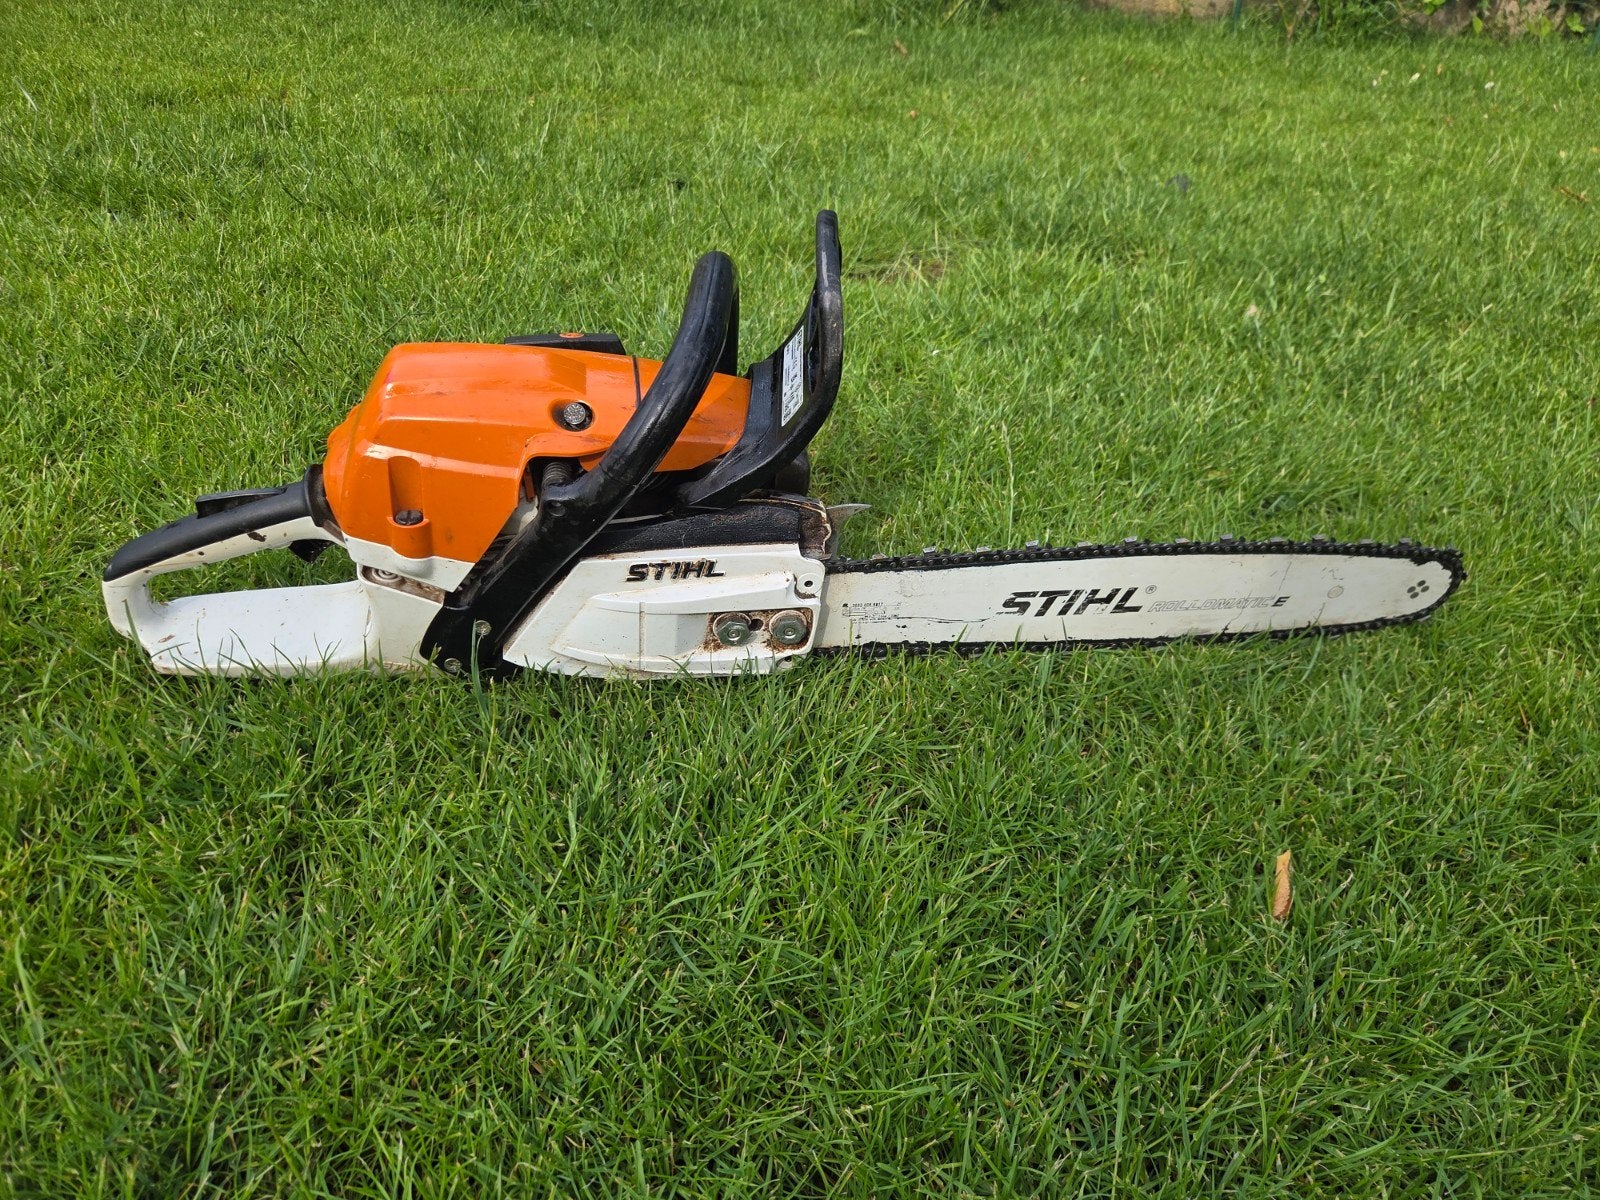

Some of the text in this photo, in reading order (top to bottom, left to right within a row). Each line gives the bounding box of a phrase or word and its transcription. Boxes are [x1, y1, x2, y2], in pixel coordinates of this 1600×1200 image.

[626, 558, 726, 582] STIHL
[1147, 596, 1273, 613] ROLLOMATIC
[1271, 596, 1291, 608] E
